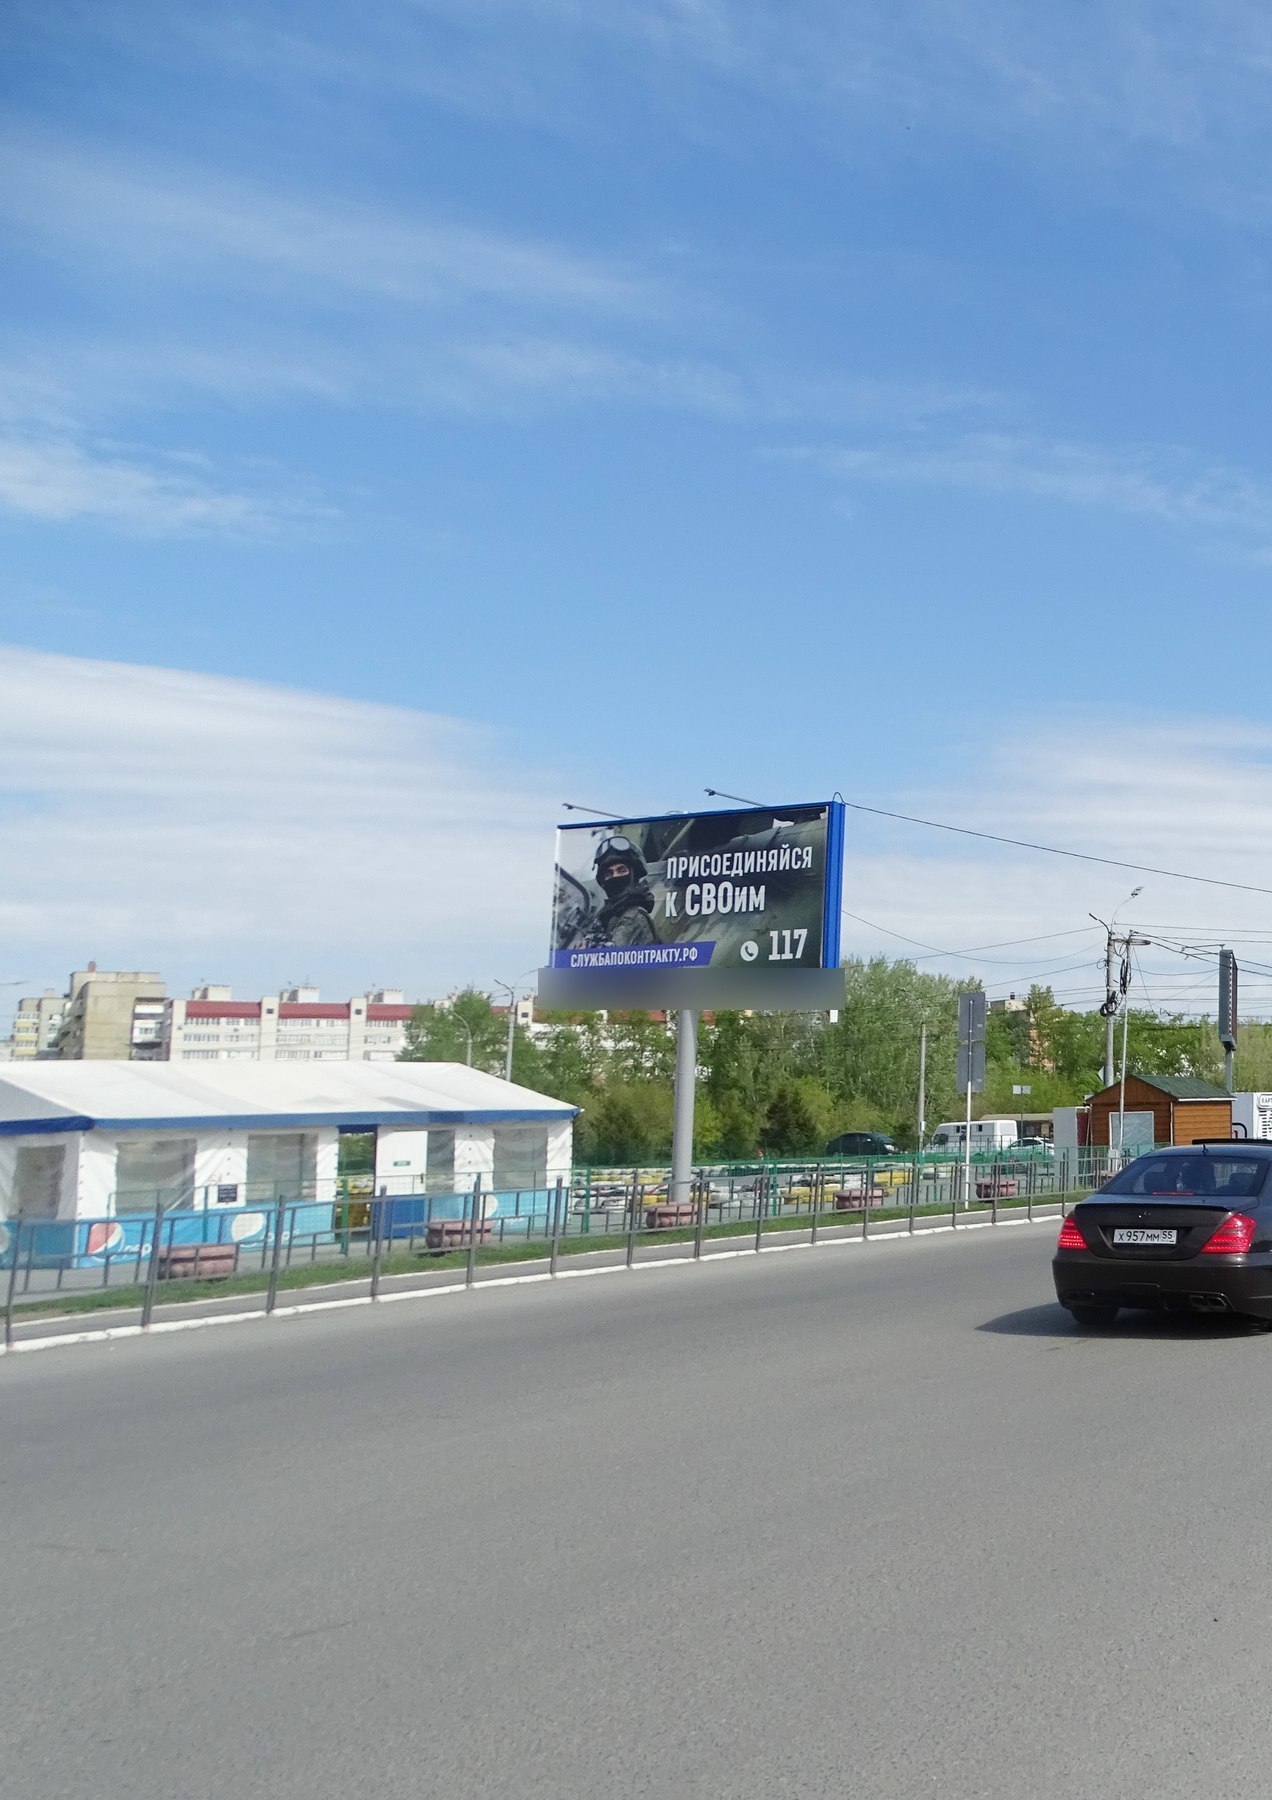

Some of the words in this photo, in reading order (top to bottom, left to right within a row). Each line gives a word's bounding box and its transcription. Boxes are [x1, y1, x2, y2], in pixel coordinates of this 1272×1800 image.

[667, 844, 813, 879] ПРИСОЕДИНЯЙСЯ
[570, 946, 698, 968] СЛУЖБАПОКОНТРАКТУ.РФ
[768, 928, 808, 961] 117
